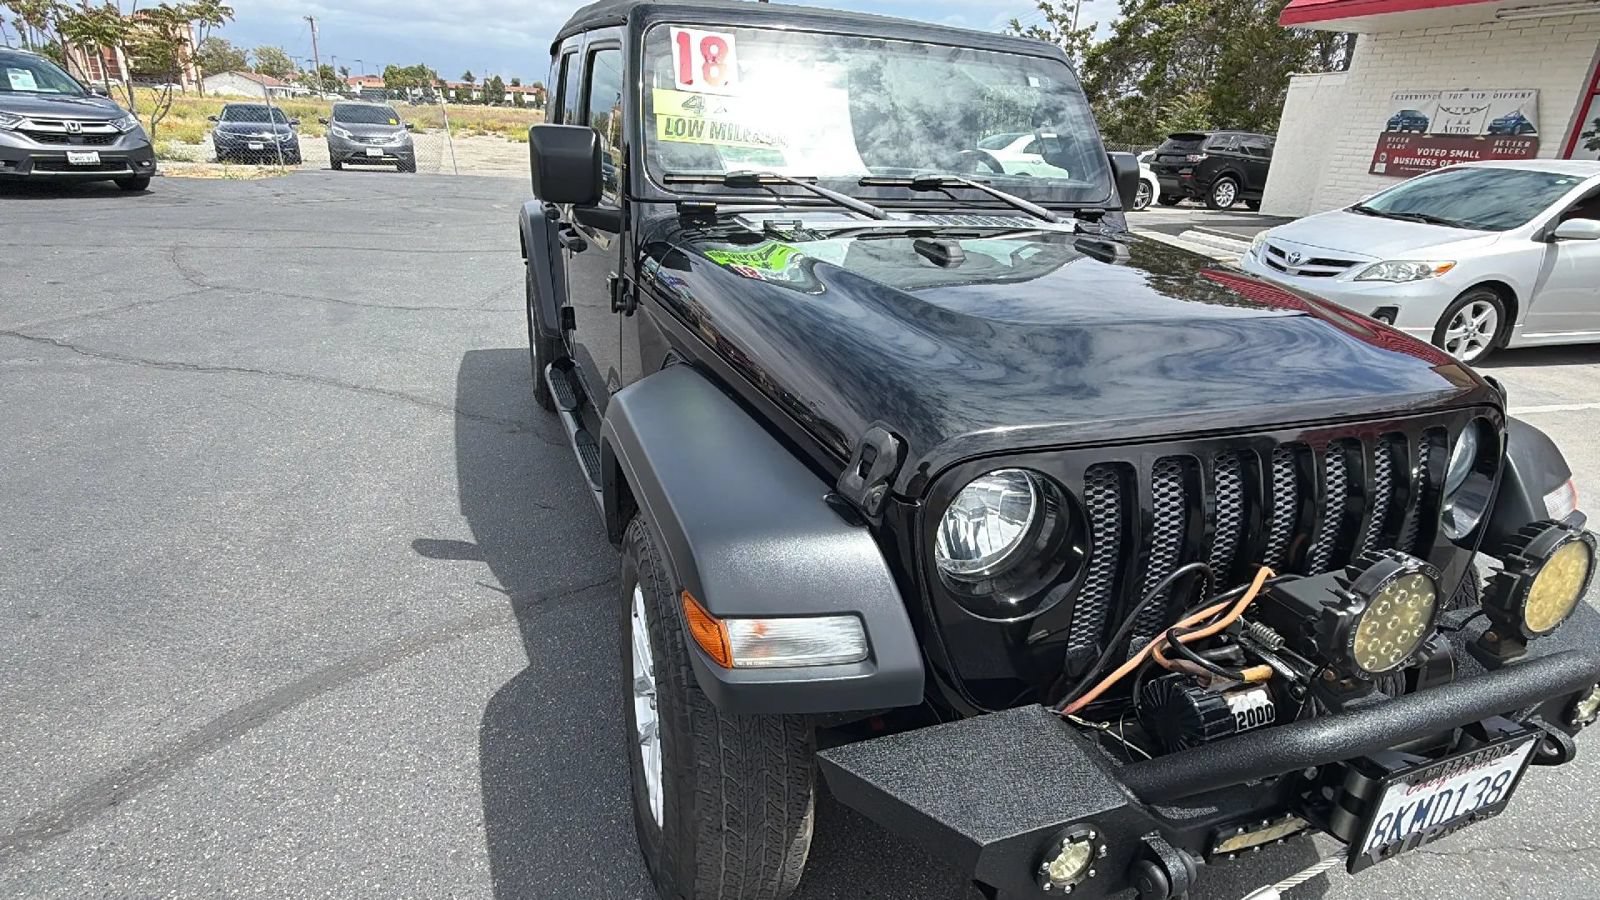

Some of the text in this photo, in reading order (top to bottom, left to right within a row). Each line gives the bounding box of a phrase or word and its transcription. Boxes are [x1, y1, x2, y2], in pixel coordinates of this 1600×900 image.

[676, 31, 729, 86] 18
[664, 118, 705, 138] LOW
[1417, 148, 1480, 158] VOTED SMALL
[1491, 147, 1527, 155] PRICES
[1393, 156, 1437, 166] BUSINESS
[1369, 769, 1512, 850] 8KMD138
